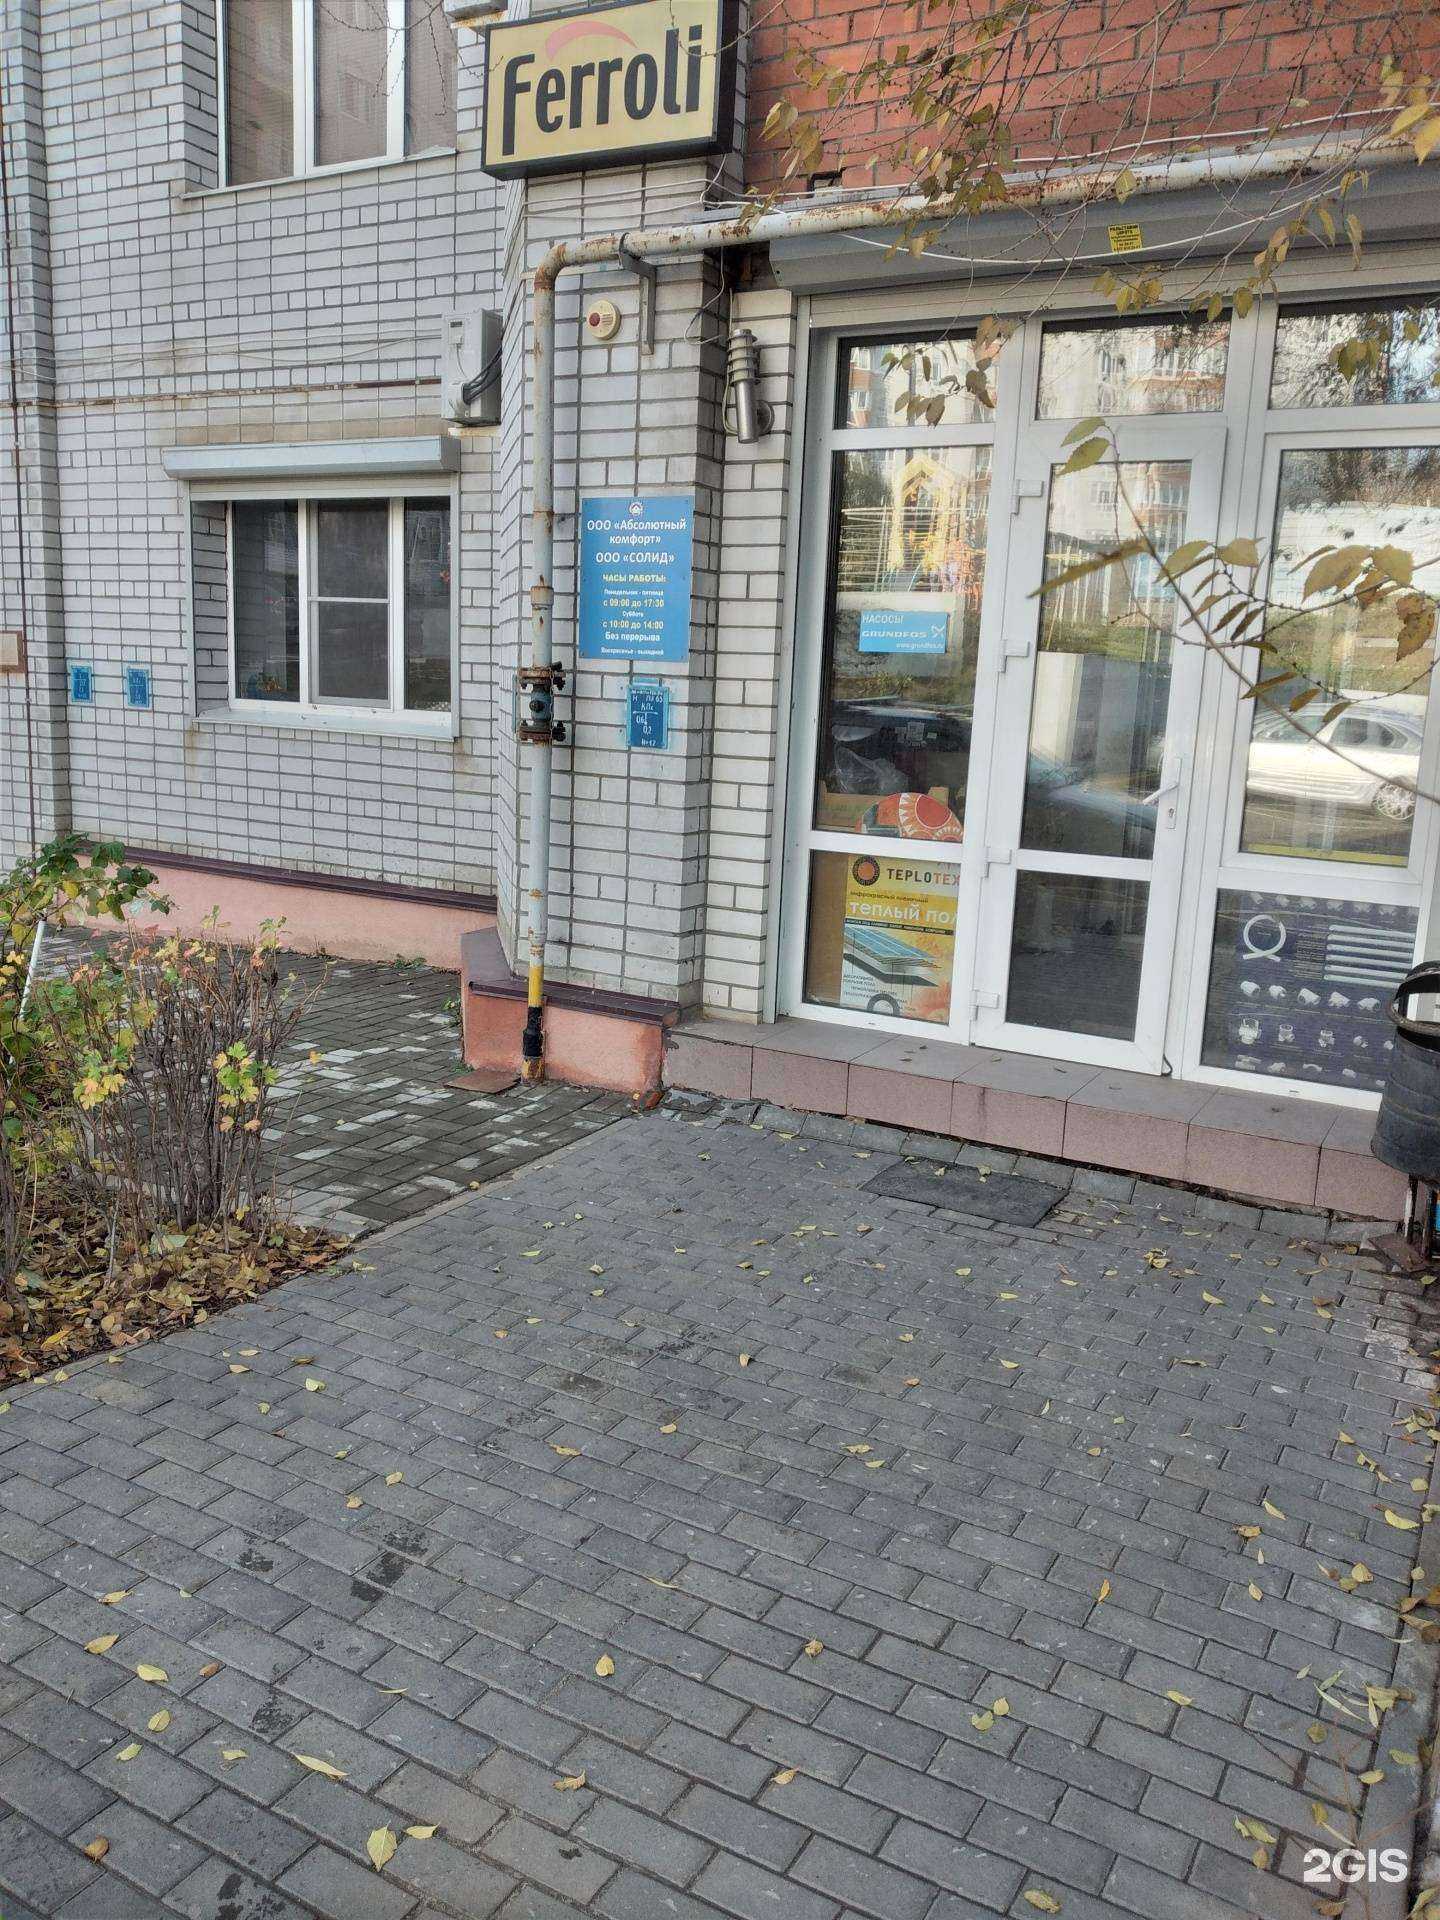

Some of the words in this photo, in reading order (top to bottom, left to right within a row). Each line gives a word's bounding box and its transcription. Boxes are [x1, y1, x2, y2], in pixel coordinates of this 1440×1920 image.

[587, 520, 611, 530] ООО
[614, 518, 687, 530] «Абсолютный
[609, 534, 661, 546] комфорт»
[596, 552, 620, 563] ООО
[623, 552, 674, 564] «СОЛИД»
[602, 574, 626, 583] ЧАСЫ
[629, 574, 666, 583] РАБОТЫ:
[632, 600, 641, 608] до
[862, 615, 904, 624] НАСОСЫ
[605, 631, 619, 640] Без
[621, 633, 660, 642] перерыва
[861, 630, 928, 638] GRUNDFOS
[886, 868, 960, 886] TEPLOTEX
